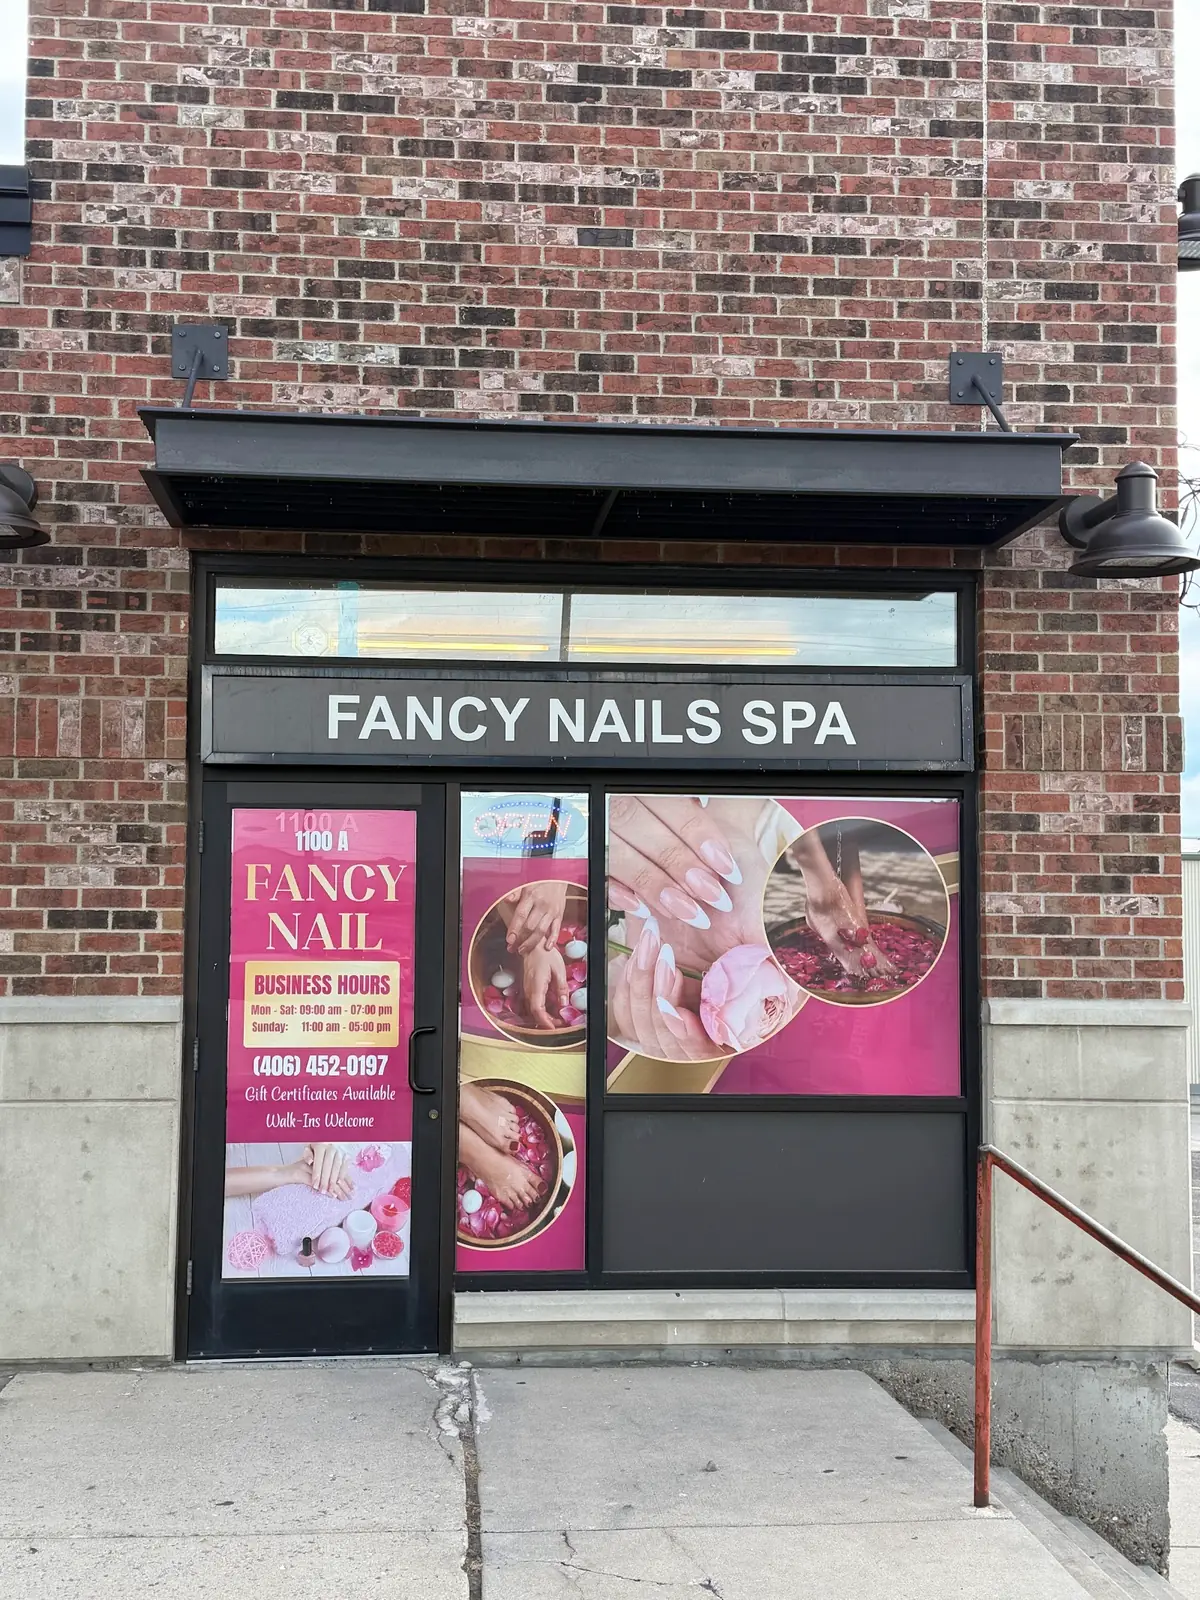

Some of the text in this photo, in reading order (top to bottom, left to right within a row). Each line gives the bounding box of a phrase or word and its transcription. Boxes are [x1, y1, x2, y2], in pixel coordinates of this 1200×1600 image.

[328, 695, 857, 745] FANCY NAILS SPA
[275, 812, 359, 832] 1100 A
[474, 812, 572, 838] OPEN
[295, 830, 349, 851] 1100 A
[244, 863, 408, 902] FANCY
[266, 912, 383, 951] NAIL
[254, 974, 391, 995] BUSINESS HOURS
[251, 1004, 271, 1015] Mon
[279, 1004, 297, 1015] Sat:
[299, 1004, 326, 1015] 09:00
[327, 1005, 342, 1015] am
[350, 1004, 376, 1015] 07:00
[378, 1005, 393, 1017] pm
[252, 1021, 289, 1034] Sunday:
[301, 1021, 324, 1032] 11:00
[325, 1022, 340, 1032] am
[348, 1021, 374, 1032] 05:00
[376, 1022, 391, 1034] pm
[253, 1055, 389, 1076] (406) 452-0197
[245, 1084, 396, 1102] Gift Certificates Available
[266, 1111, 375, 1128] Walk-Ins Welcome
